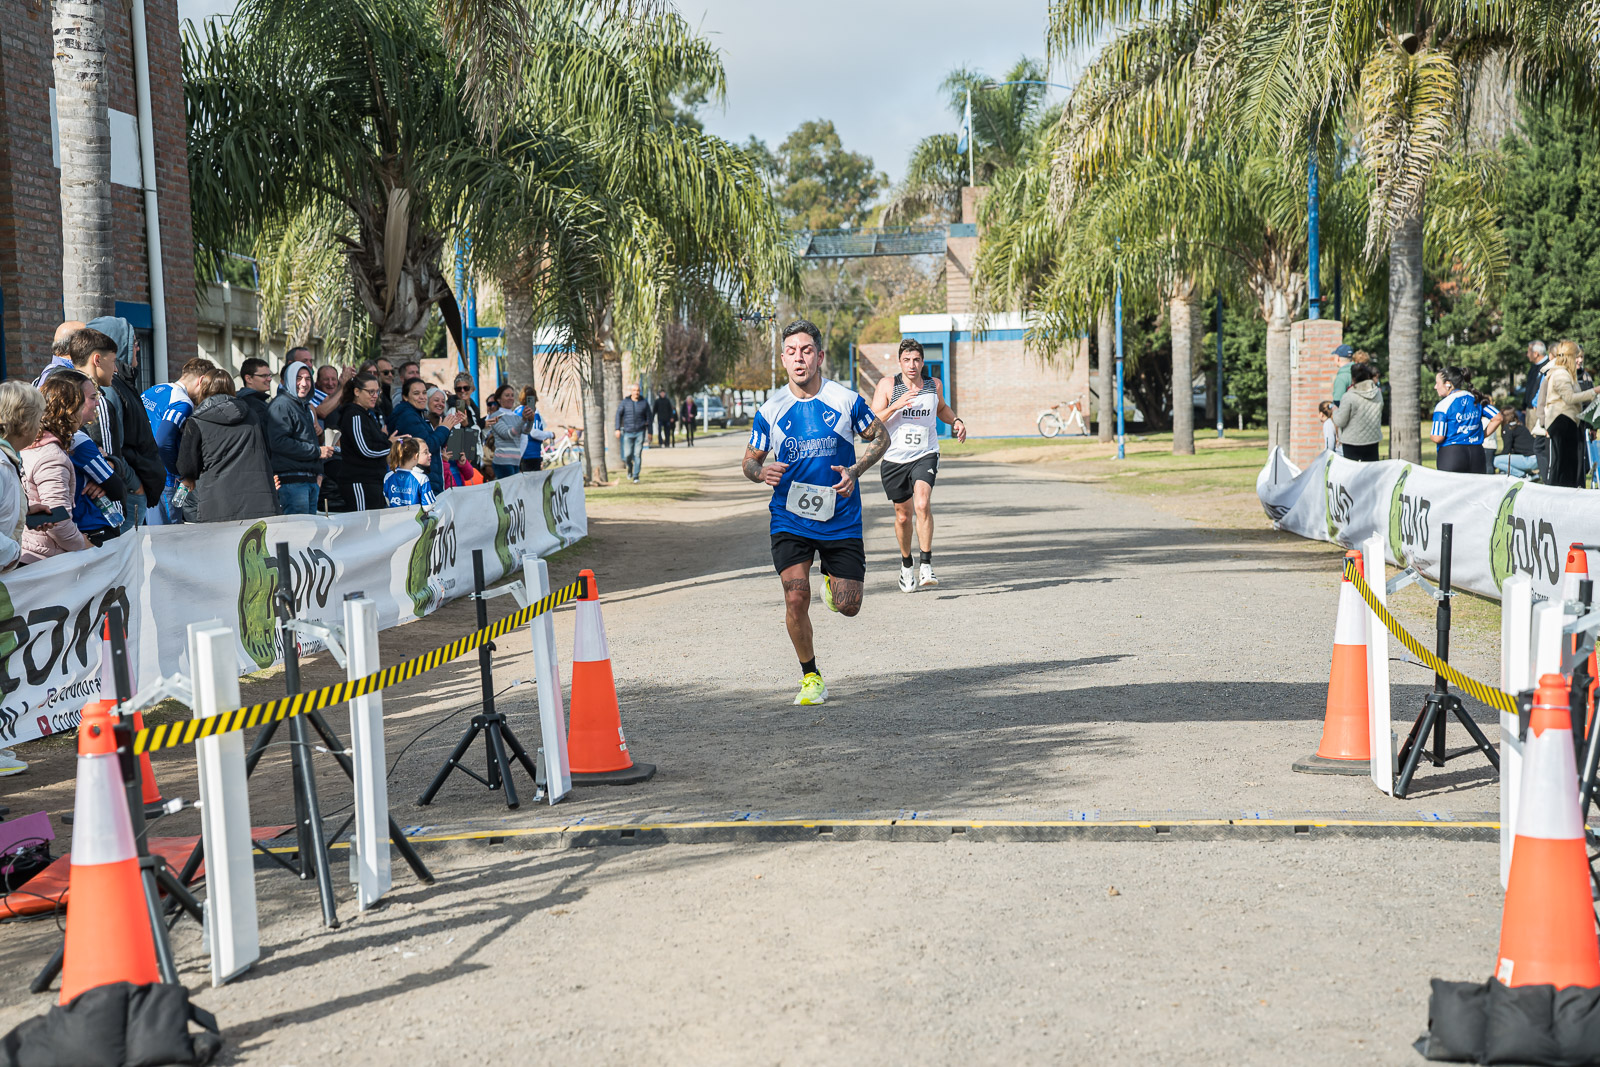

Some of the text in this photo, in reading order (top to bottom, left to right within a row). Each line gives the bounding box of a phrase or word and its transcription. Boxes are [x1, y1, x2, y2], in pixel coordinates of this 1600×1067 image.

[902, 408, 930, 417] ATENAS
[904, 433, 922, 445] 55
[784, 436, 799, 462] 3
[798, 493, 824, 512] 69
